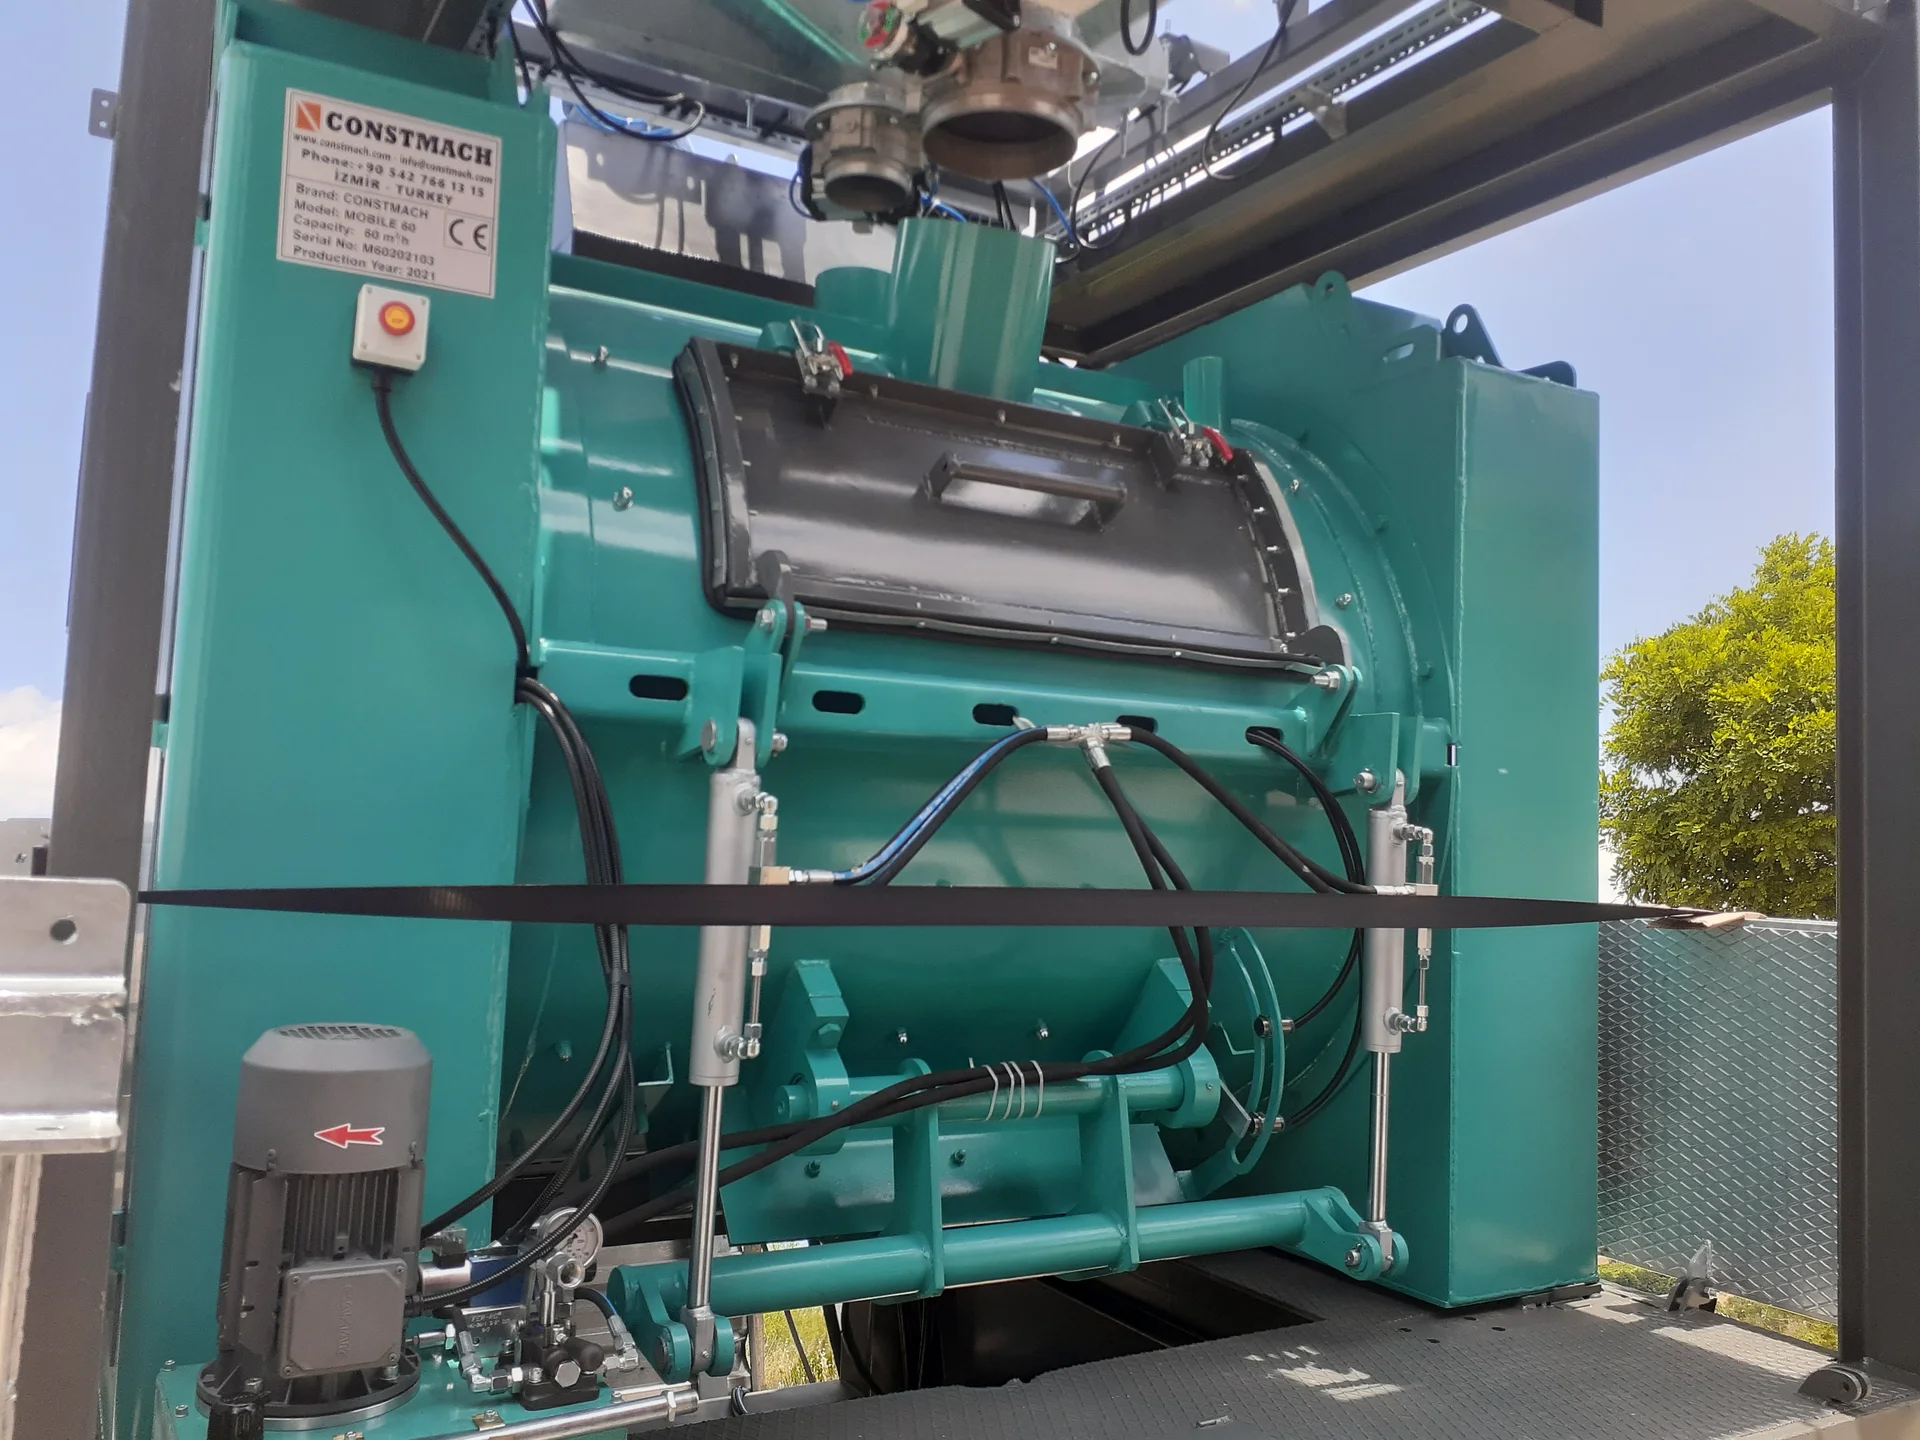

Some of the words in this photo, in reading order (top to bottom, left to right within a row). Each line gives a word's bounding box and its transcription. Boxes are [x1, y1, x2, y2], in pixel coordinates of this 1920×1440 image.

[293, 133, 391, 161] www.constmach.com
[327, 111, 492, 166] CONSTMACH
[335, 167, 380, 190] İZMİR
[396, 183, 452, 205] TURKEY
[389, 167, 415, 182] 542
[420, 174, 445, 188] 766
[451, 181, 464, 193] 13
[470, 185, 484, 198] 15
[294, 198, 339, 218] Model:
[401, 220, 416, 233] 60
[296, 182, 338, 200] Brand:
[344, 192, 429, 219] CONSTMACH
[293, 229, 330, 246] Serial
[336, 237, 357, 250] No:
[294, 214, 355, 236] Capacity:
[364, 228, 380, 240] 60
[448, 218, 488, 251] CE
[294, 244, 366, 268] Production
[372, 260, 401, 274] Year:
[407, 267, 435, 280] 2021
